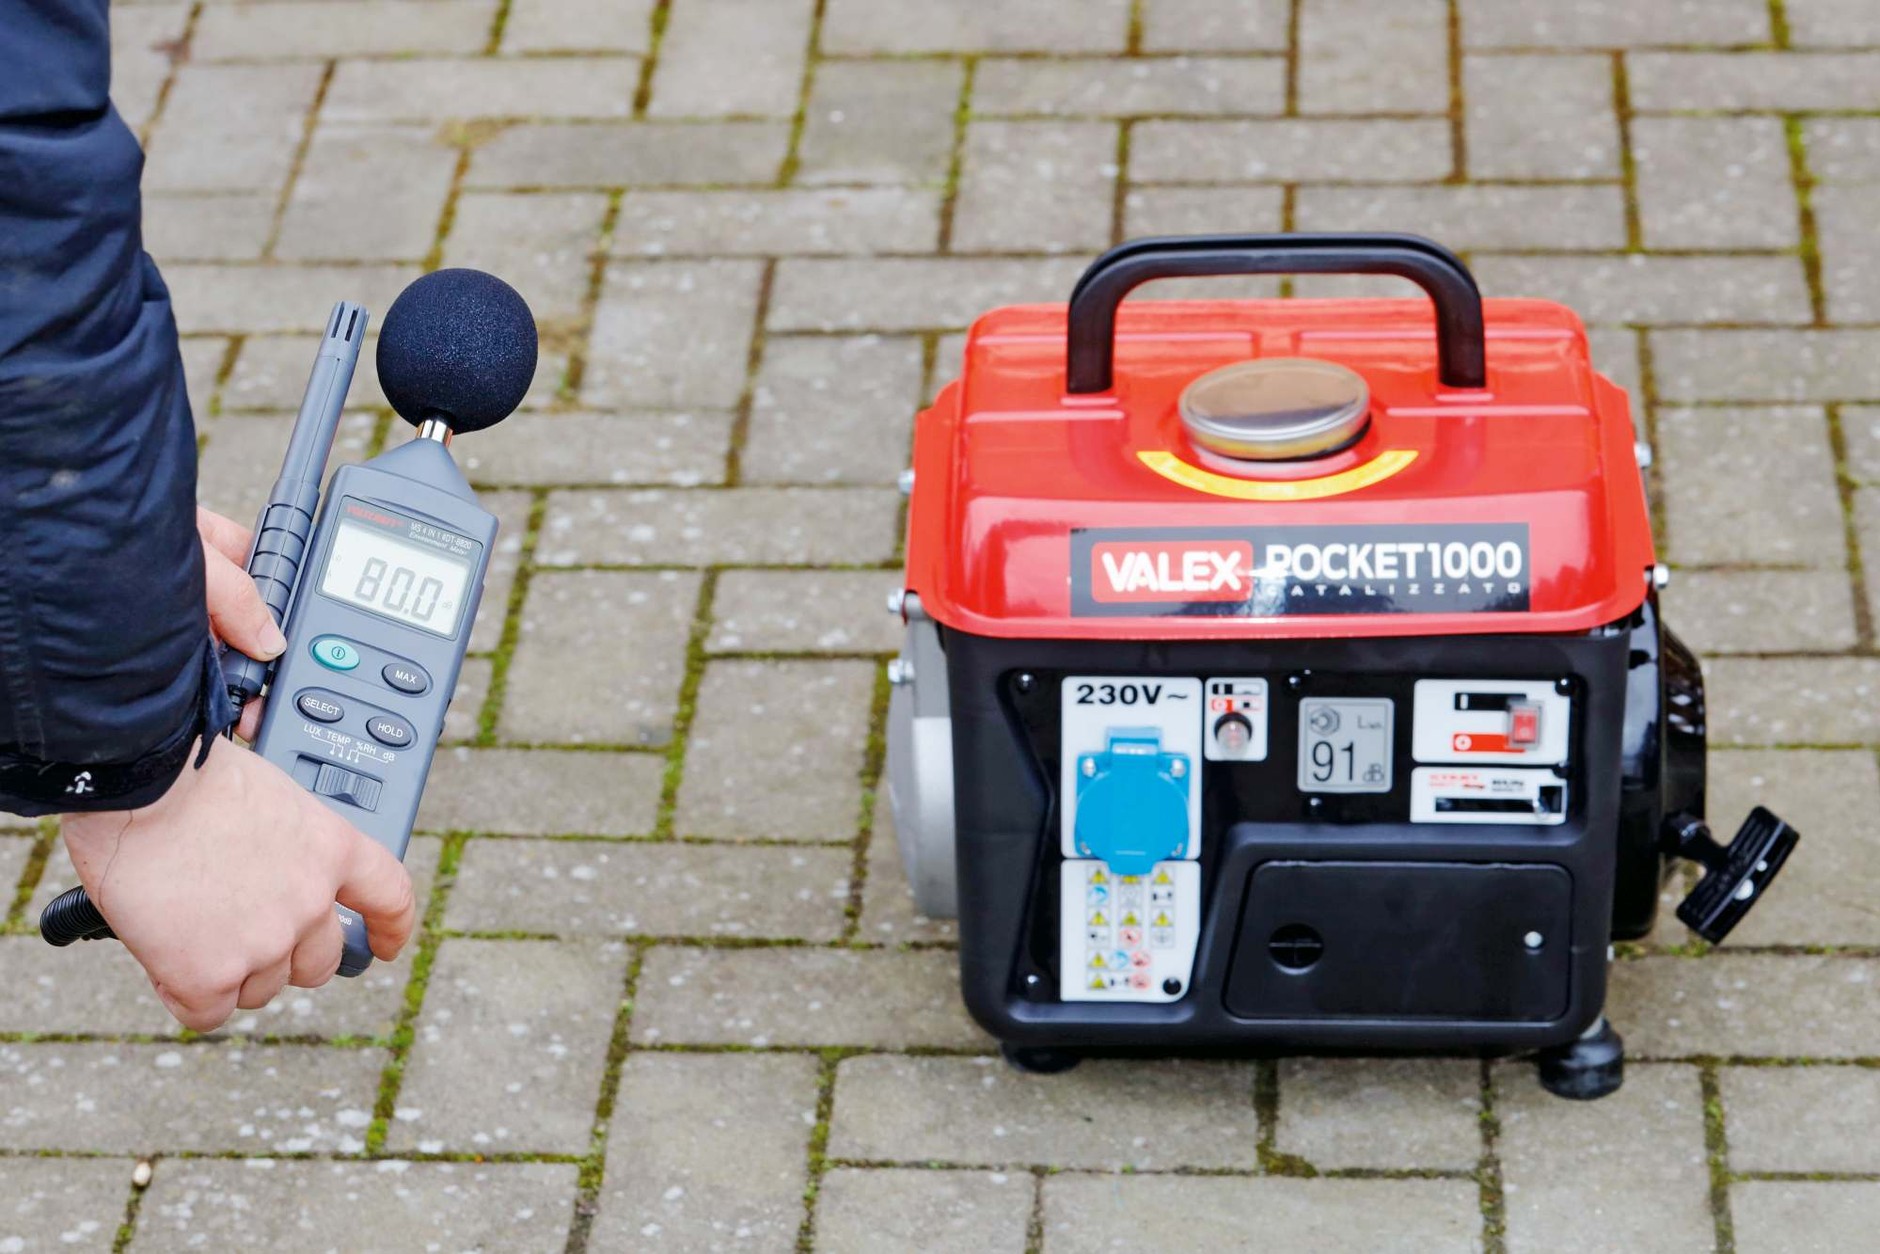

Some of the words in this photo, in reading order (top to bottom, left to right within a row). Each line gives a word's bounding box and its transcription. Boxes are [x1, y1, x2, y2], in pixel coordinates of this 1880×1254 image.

[1101, 551, 1242, 594] VALEX
[354, 556, 444, 622] 80.0
[1267, 583, 1521, 595] CATALIZZATO
[395, 670, 417, 684] MAX
[304, 697, 340, 716] SELECT
[303, 723, 322, 736] LUX
[326, 731, 352, 745] TEMP
[356, 741, 377, 755] %RH
[382, 752, 396, 762] dB
[377, 722, 403, 738] HOLD
[1312, 741, 1355, 783] 91
[1363, 763, 1385, 783] dB
